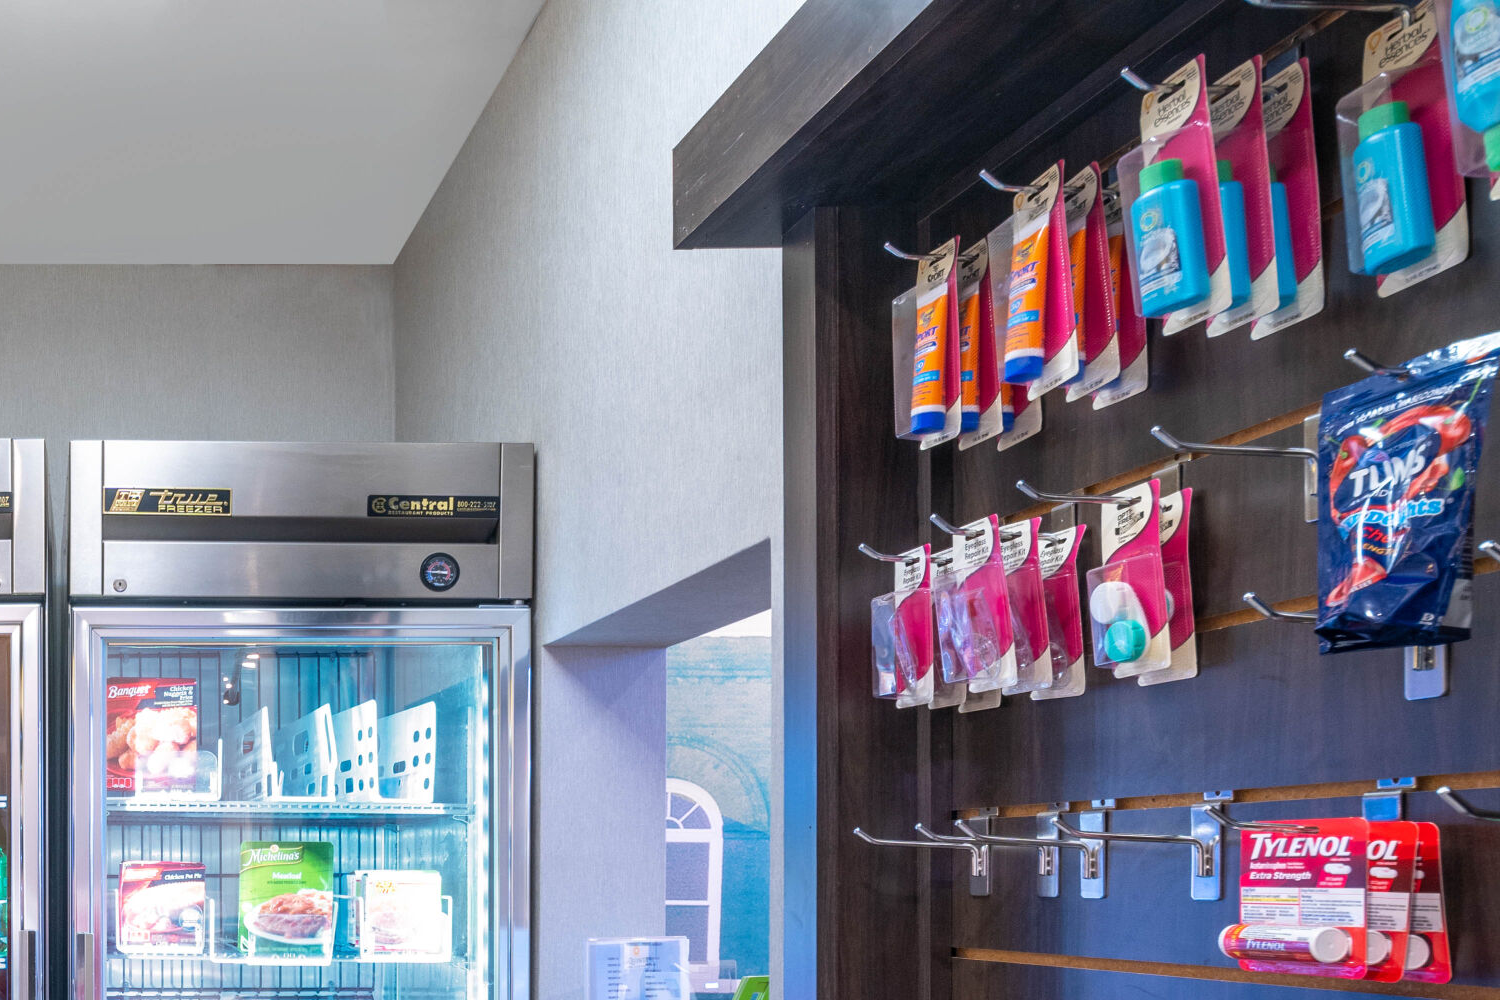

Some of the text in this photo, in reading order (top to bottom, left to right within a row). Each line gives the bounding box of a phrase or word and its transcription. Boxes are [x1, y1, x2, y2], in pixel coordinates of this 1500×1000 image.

[1348, 444, 1427, 498] TUMS
[149, 489, 223, 505] true
[388, 497, 455, 511] Central
[158, 504, 223, 513] FREEZER
[964, 538, 986, 552] Eyeglass
[964, 549, 981, 560] Repair
[108, 684, 152, 699] Banquet
[1250, 833, 1352, 861] TYLENOL
[241, 849, 301, 867] Michelina's
[164, 873, 184, 881] Chicken
[1249, 871, 1272, 880] Extra
[1273, 871, 1312, 882] Strength
